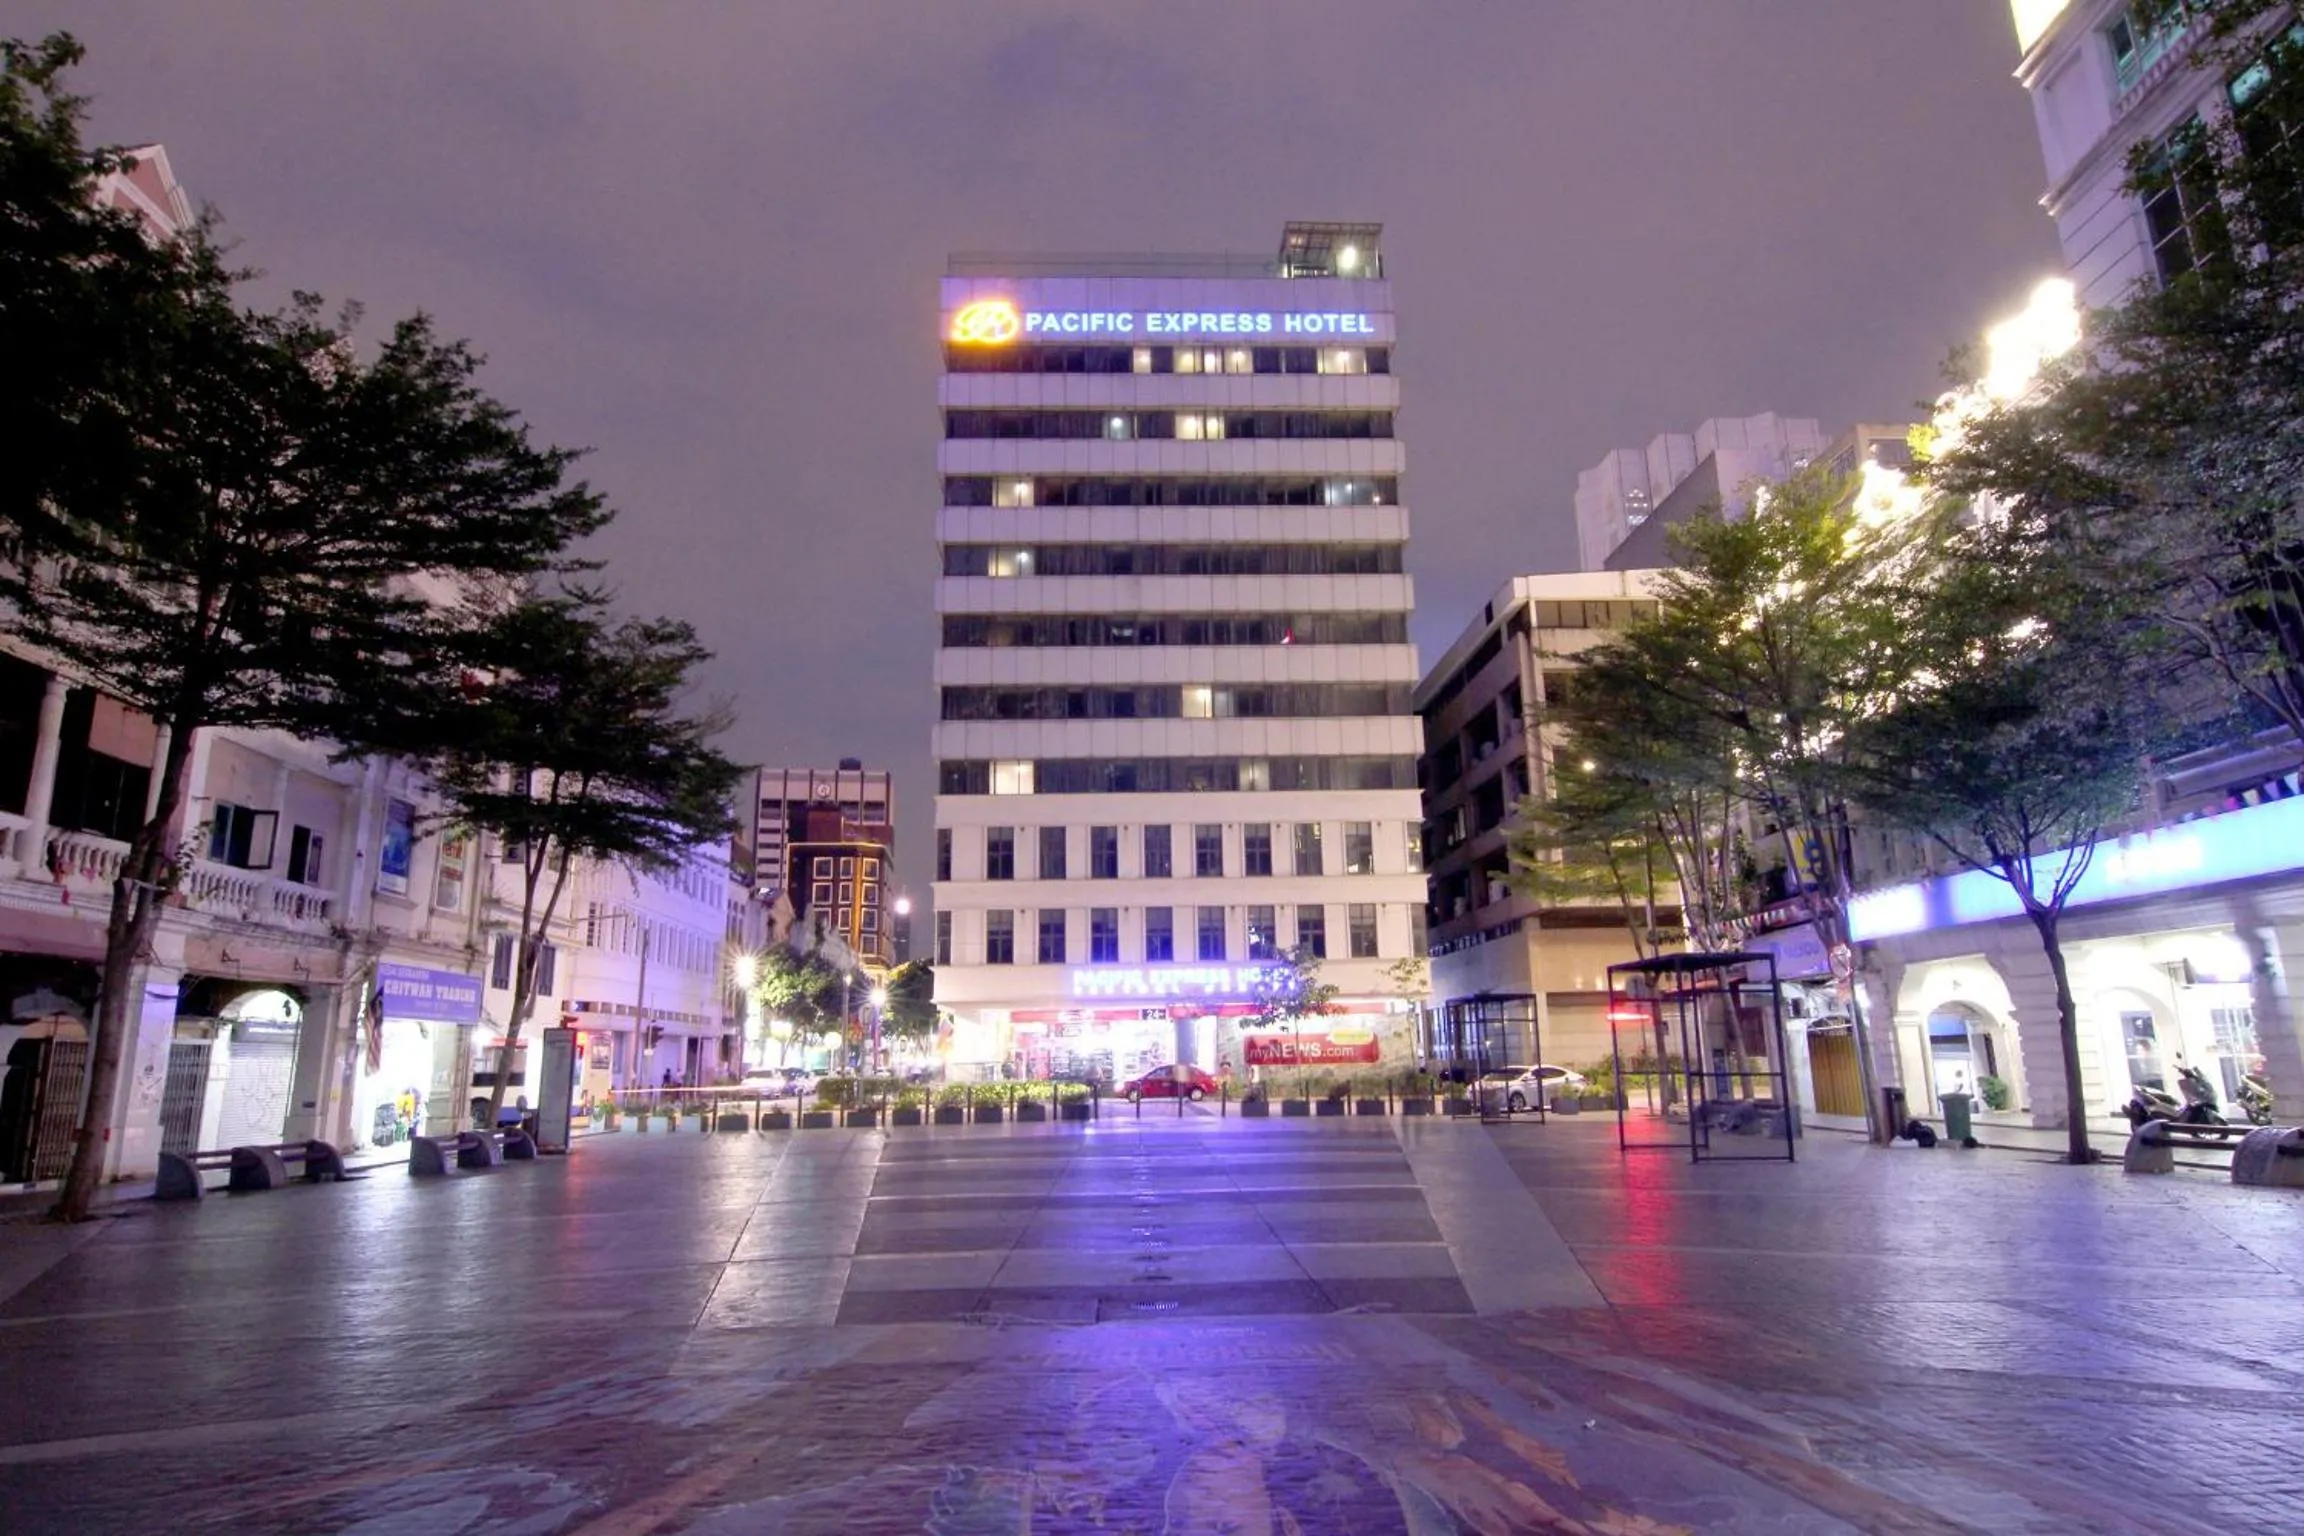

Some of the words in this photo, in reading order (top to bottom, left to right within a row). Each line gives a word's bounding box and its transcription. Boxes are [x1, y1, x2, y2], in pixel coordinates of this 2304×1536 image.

[1026, 312, 1134, 332] PACIFIC
[1146, 312, 1272, 333] EXPRESS
[1283, 313, 1375, 333] HOTEL
[1250, 1042, 1354, 1061] myNEWS.com
